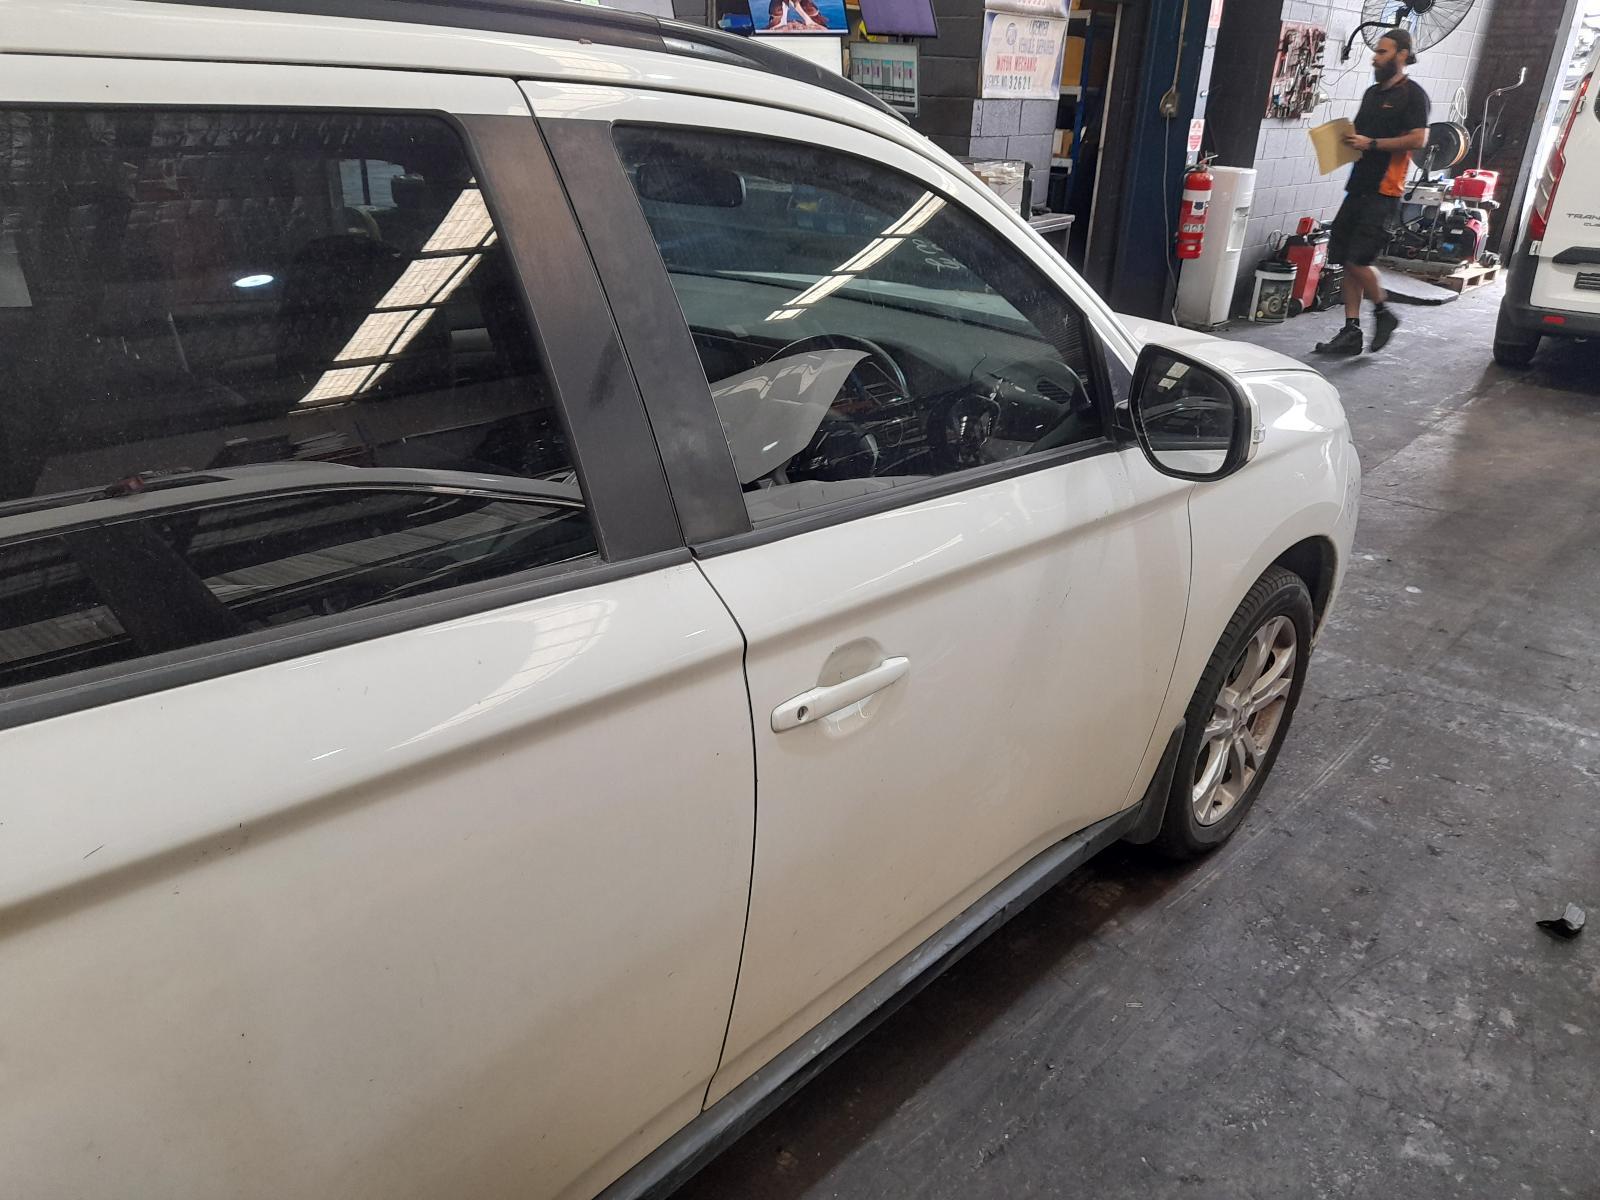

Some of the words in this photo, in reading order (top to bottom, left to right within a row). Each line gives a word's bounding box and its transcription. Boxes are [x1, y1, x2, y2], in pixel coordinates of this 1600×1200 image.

[995, 54, 1013, 72] MOTOR
[1014, 55, 1038, 73] MECHANIC
[1008, 76, 1032, 91] 32621
